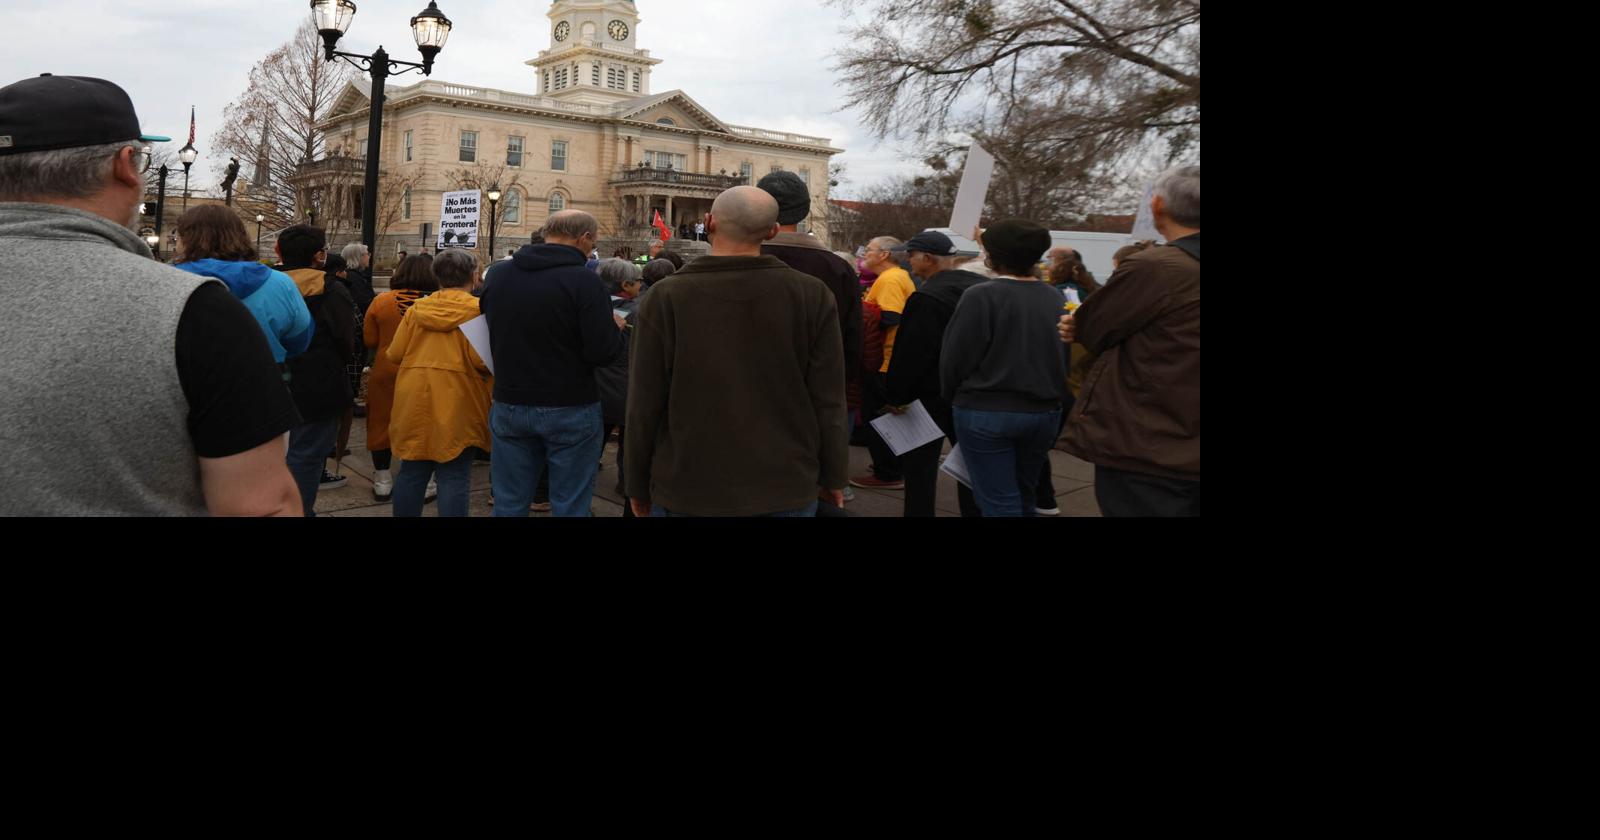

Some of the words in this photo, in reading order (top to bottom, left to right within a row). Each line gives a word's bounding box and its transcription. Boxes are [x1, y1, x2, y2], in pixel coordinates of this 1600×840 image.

[460, 197, 477, 205] Más
[445, 206, 477, 214] Muertes
[441, 220, 477, 228] Frontera!
